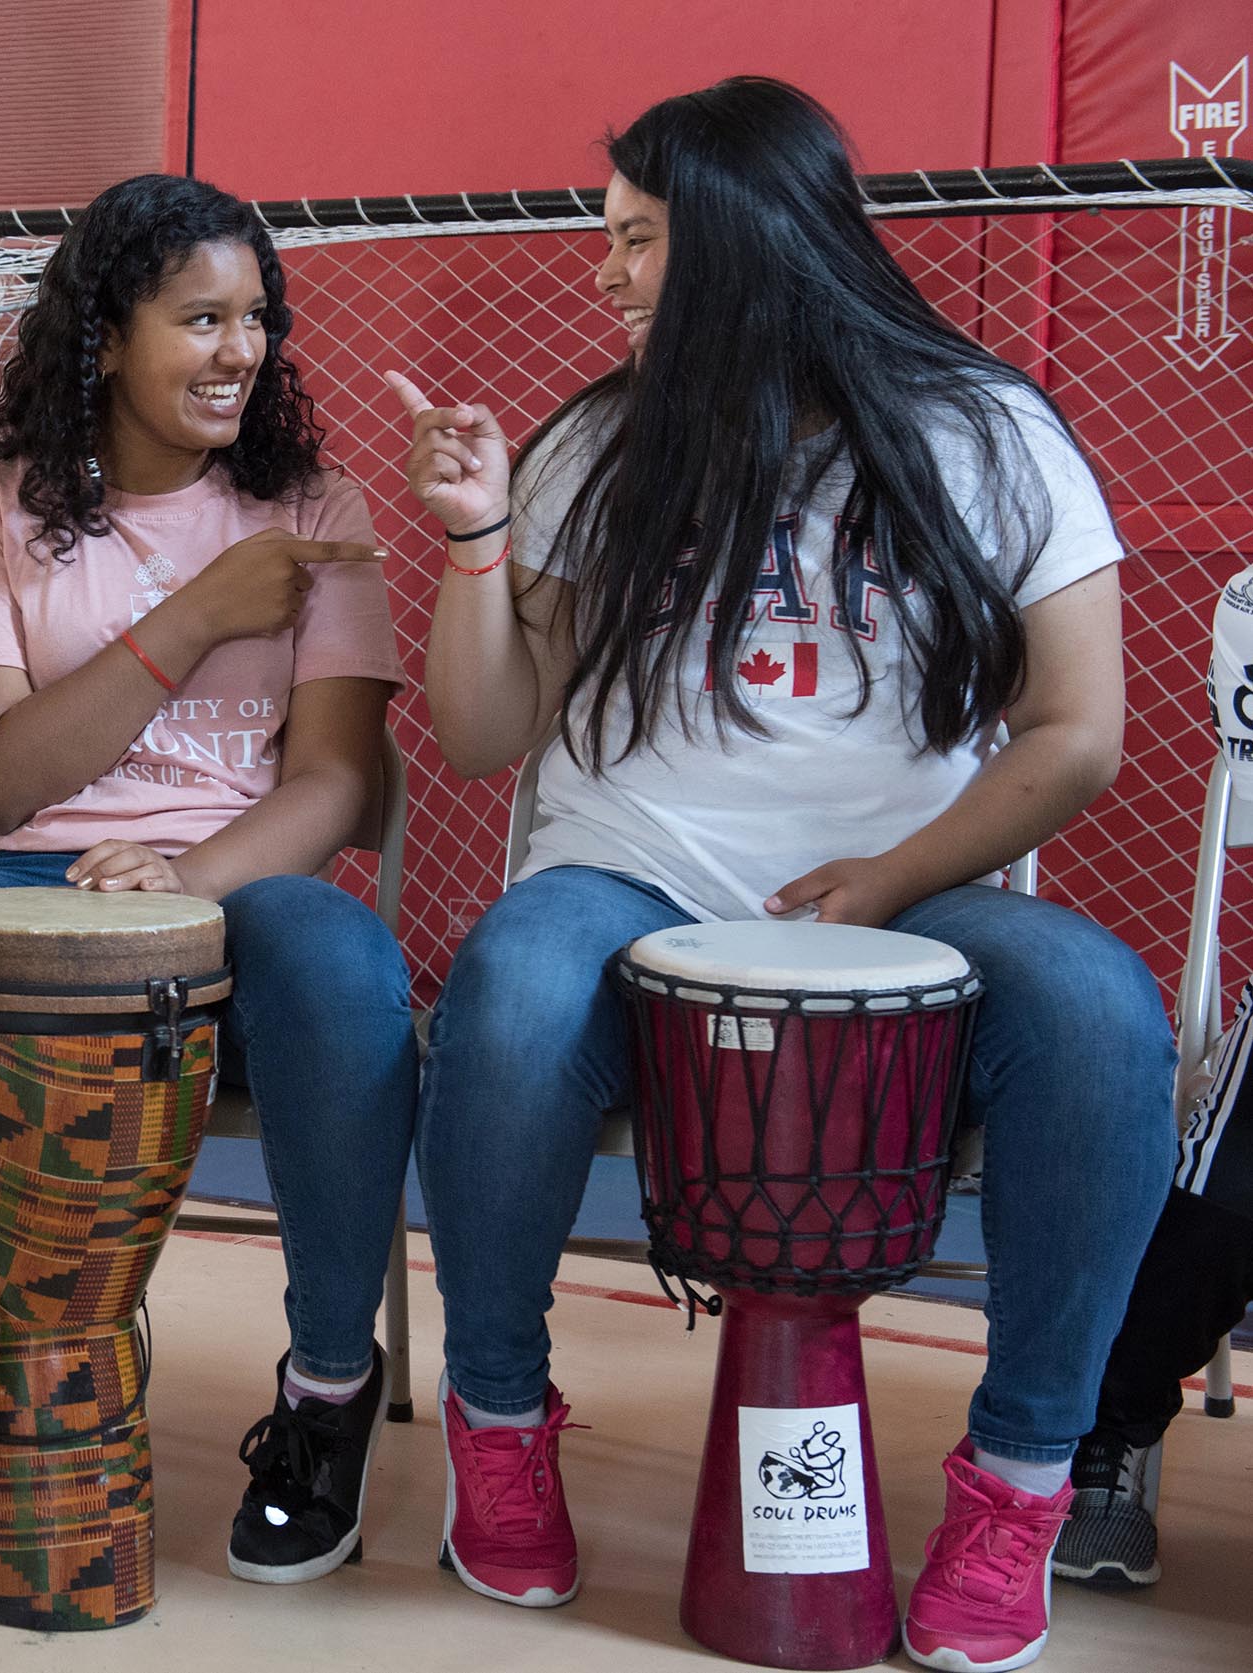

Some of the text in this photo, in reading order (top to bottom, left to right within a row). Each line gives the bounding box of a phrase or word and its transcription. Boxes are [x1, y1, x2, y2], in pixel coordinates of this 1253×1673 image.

[1178, 101, 1240, 131] FIRE
[1195, 140, 1217, 338] ENGUISHER
[238, 698, 274, 718] OF
[752, 1504, 857, 1521] SOUL DRUMS
